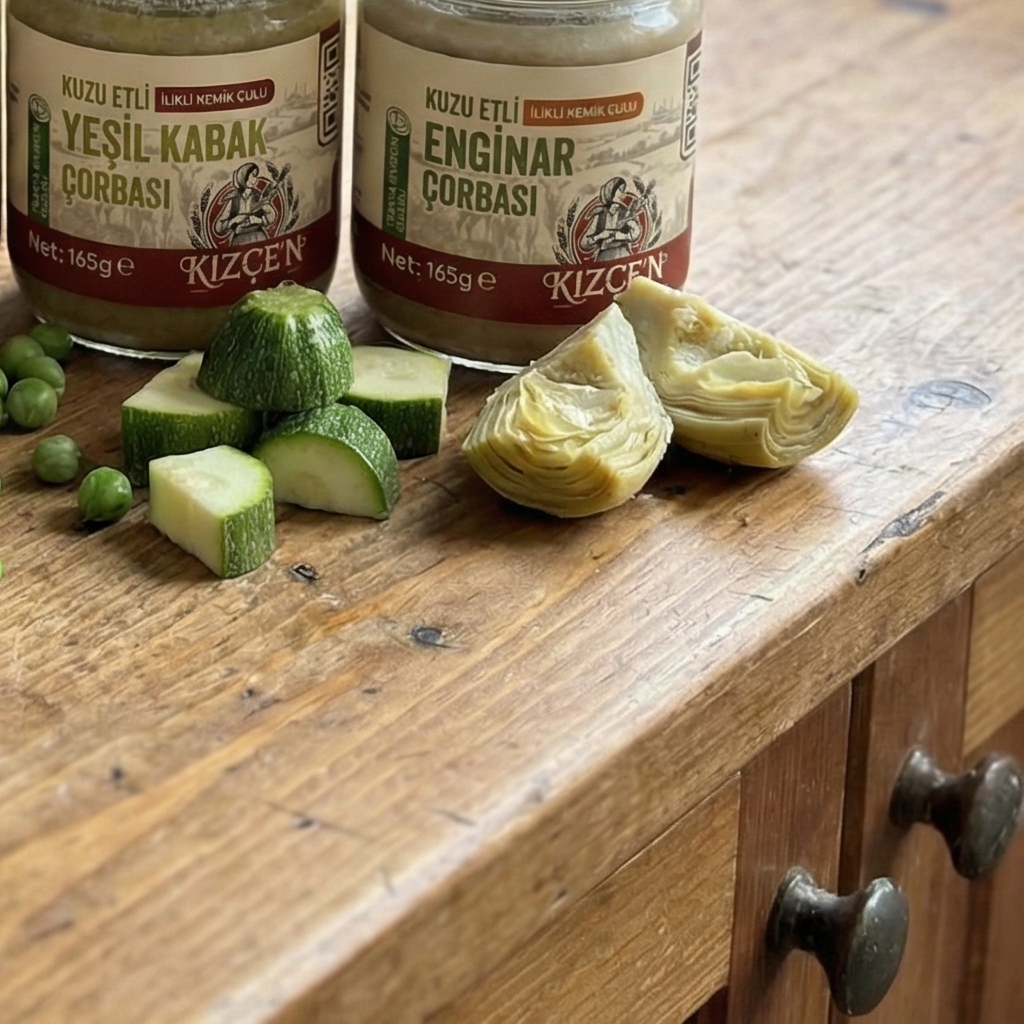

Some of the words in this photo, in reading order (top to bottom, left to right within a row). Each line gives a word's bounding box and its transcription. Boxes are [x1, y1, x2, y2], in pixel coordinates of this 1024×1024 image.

[62, 74, 107, 106] KUZU
[112, 83, 150, 110] ETLİ
[426, 86, 474, 119] KUZU
[479, 95, 519, 124] ETLİ
[62, 109, 150, 171] YEŞİL
[160, 117, 268, 163] KABAK
[424, 121, 576, 177] ENGİNAR
[62, 163, 170, 210] ÇORBASI
[421, 169, 538, 217] ÇORBASI
[28, 230, 64, 264] Net:
[67, 248, 113, 278] 165g
[381, 243, 421, 278] Net:
[427, 261, 473, 292] 165g
